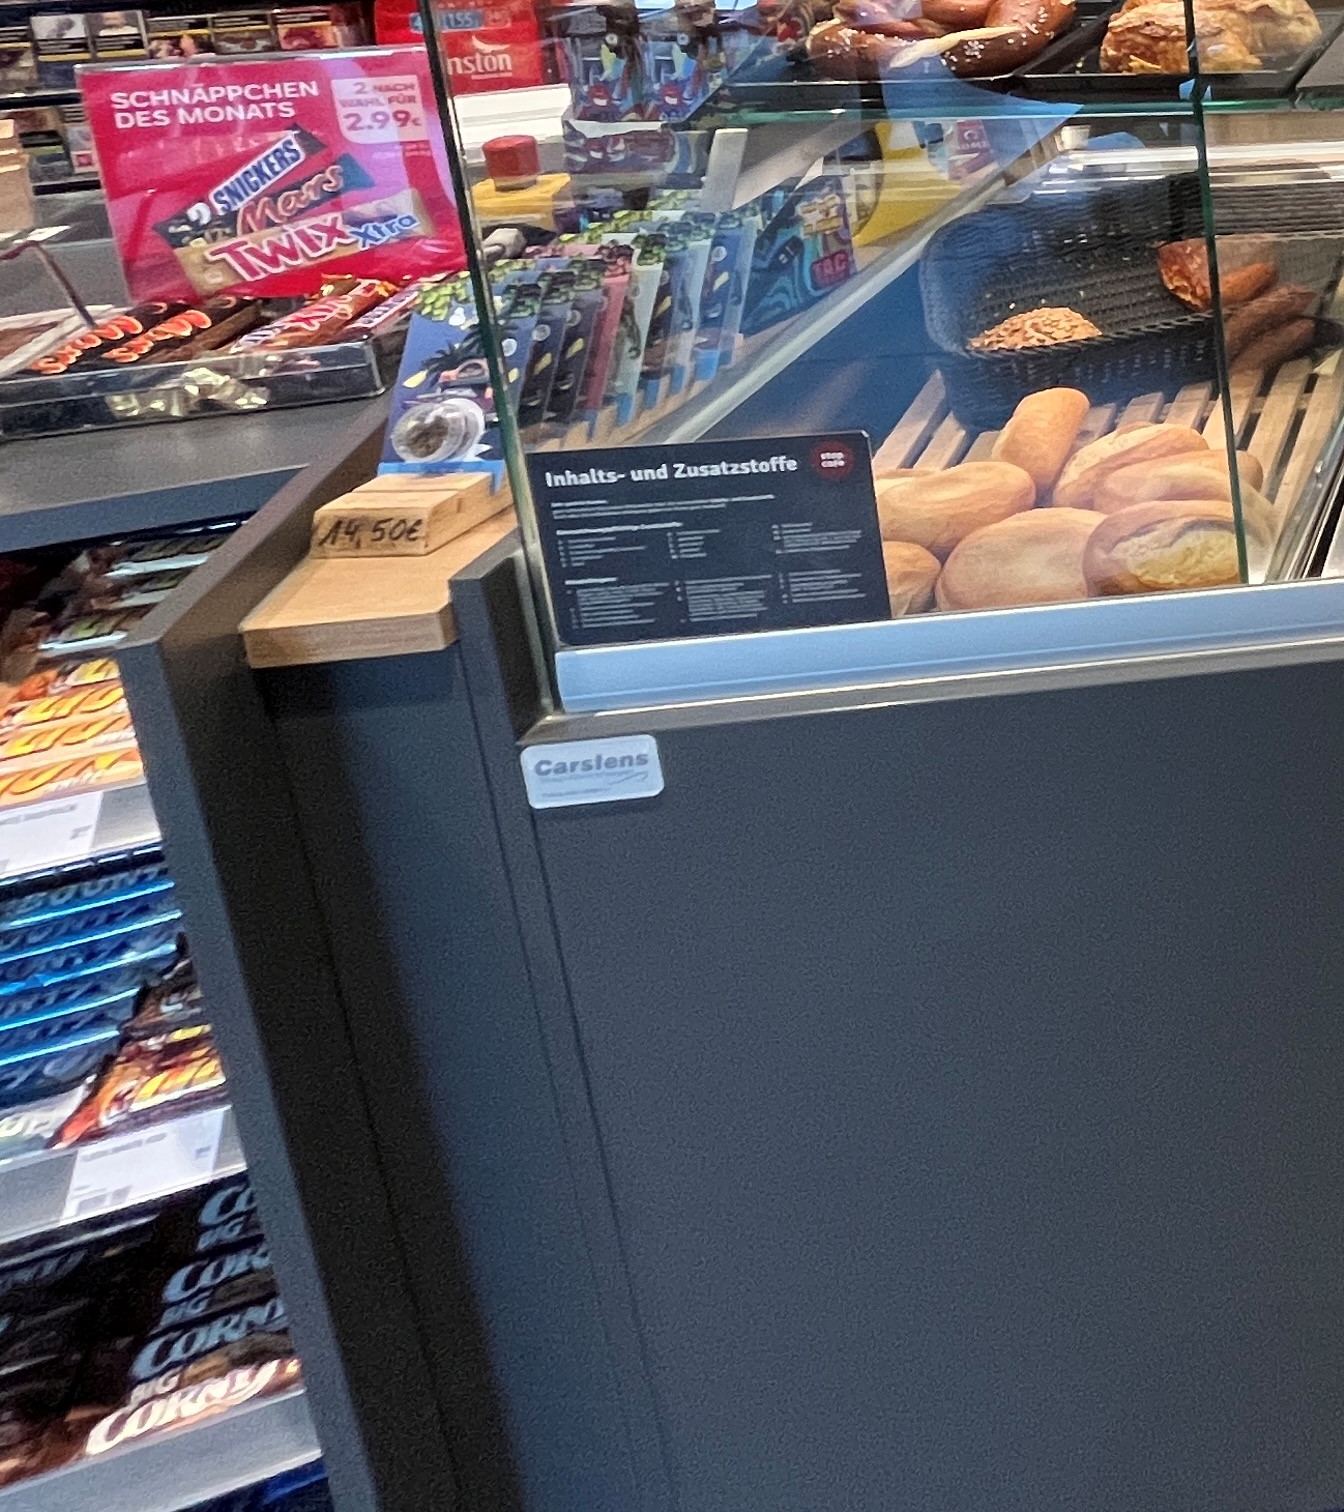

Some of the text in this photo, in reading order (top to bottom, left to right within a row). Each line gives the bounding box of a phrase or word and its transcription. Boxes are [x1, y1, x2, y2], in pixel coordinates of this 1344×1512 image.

[447, 51, 513, 76] nston
[110, 78, 320, 111] SCHNÄPPCHEN
[353, 80, 368, 96] 2
[389, 91, 418, 107] FÜR
[114, 100, 296, 130] DES MONATS
[212, 134, 303, 216] SNICKERS
[352, 210, 420, 252] Xtra
[545, 455, 798, 488] Inhalts- und Zusatzstoffe
